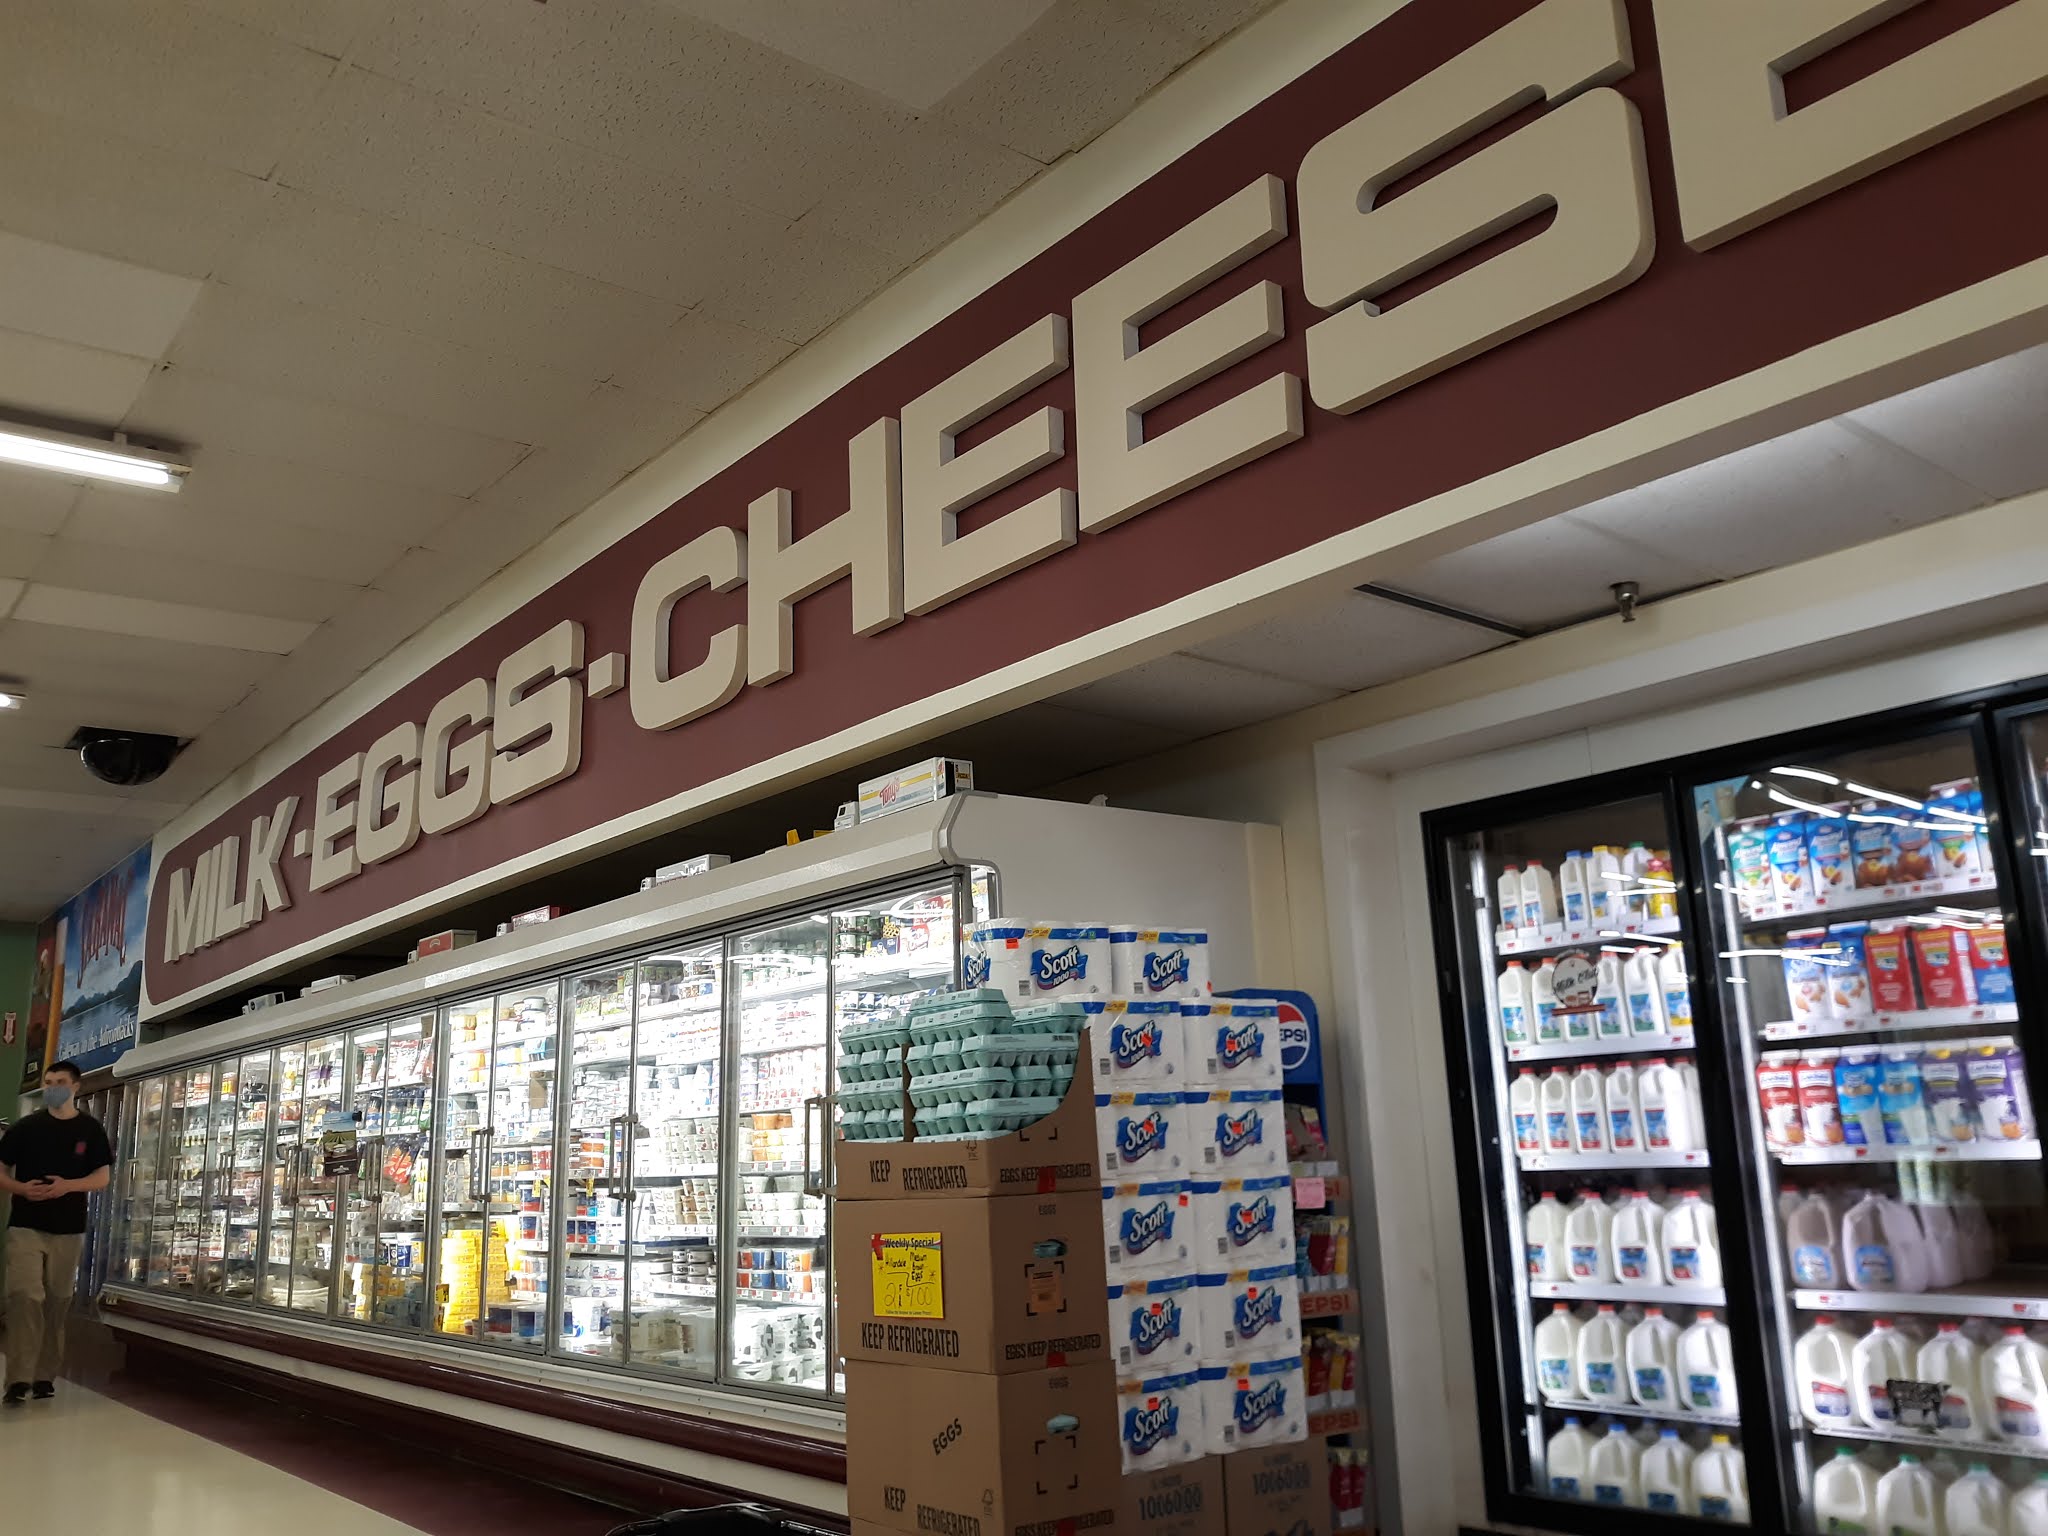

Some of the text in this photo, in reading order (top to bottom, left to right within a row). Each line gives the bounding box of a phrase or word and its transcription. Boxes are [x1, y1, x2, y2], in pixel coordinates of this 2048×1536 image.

[163, 796, 291, 963] MILK
[309, 619, 585, 893] EGGS
[967, 951, 987, 983] Scott
[1040, 945, 1079, 979] Scott
[1052, 970, 1070, 986] 1000
[1150, 949, 1183, 982] Scott
[1280, 1028, 1307, 1042] EPSI
[869, 1159, 968, 1191] KEEP REFRIGERATED
[1000, 1166, 1020, 1183] EGGS
[1129, 1200, 1168, 1243] Scott
[885, 1237, 934, 1251] Weekly Special
[1139, 1298, 1174, 1342] Scott
[1242, 1285, 1275, 1327] Scott
[1302, 1294, 1350, 1314] EPSI
[861, 1322, 960, 1358] KEEP REFRIGERATED
[1005, 1344, 1027, 1360] EGGS
[1027, 1340, 1047, 1358] KEEP
[1242, 1379, 1281, 1421] Scott
[932, 1417, 963, 1455] EGGS
[1133, 1397, 1171, 1442] Scott
[1310, 1413, 1360, 1434] EPSI
[884, 1484, 981, 1536] KEEP REFRIGERATED
